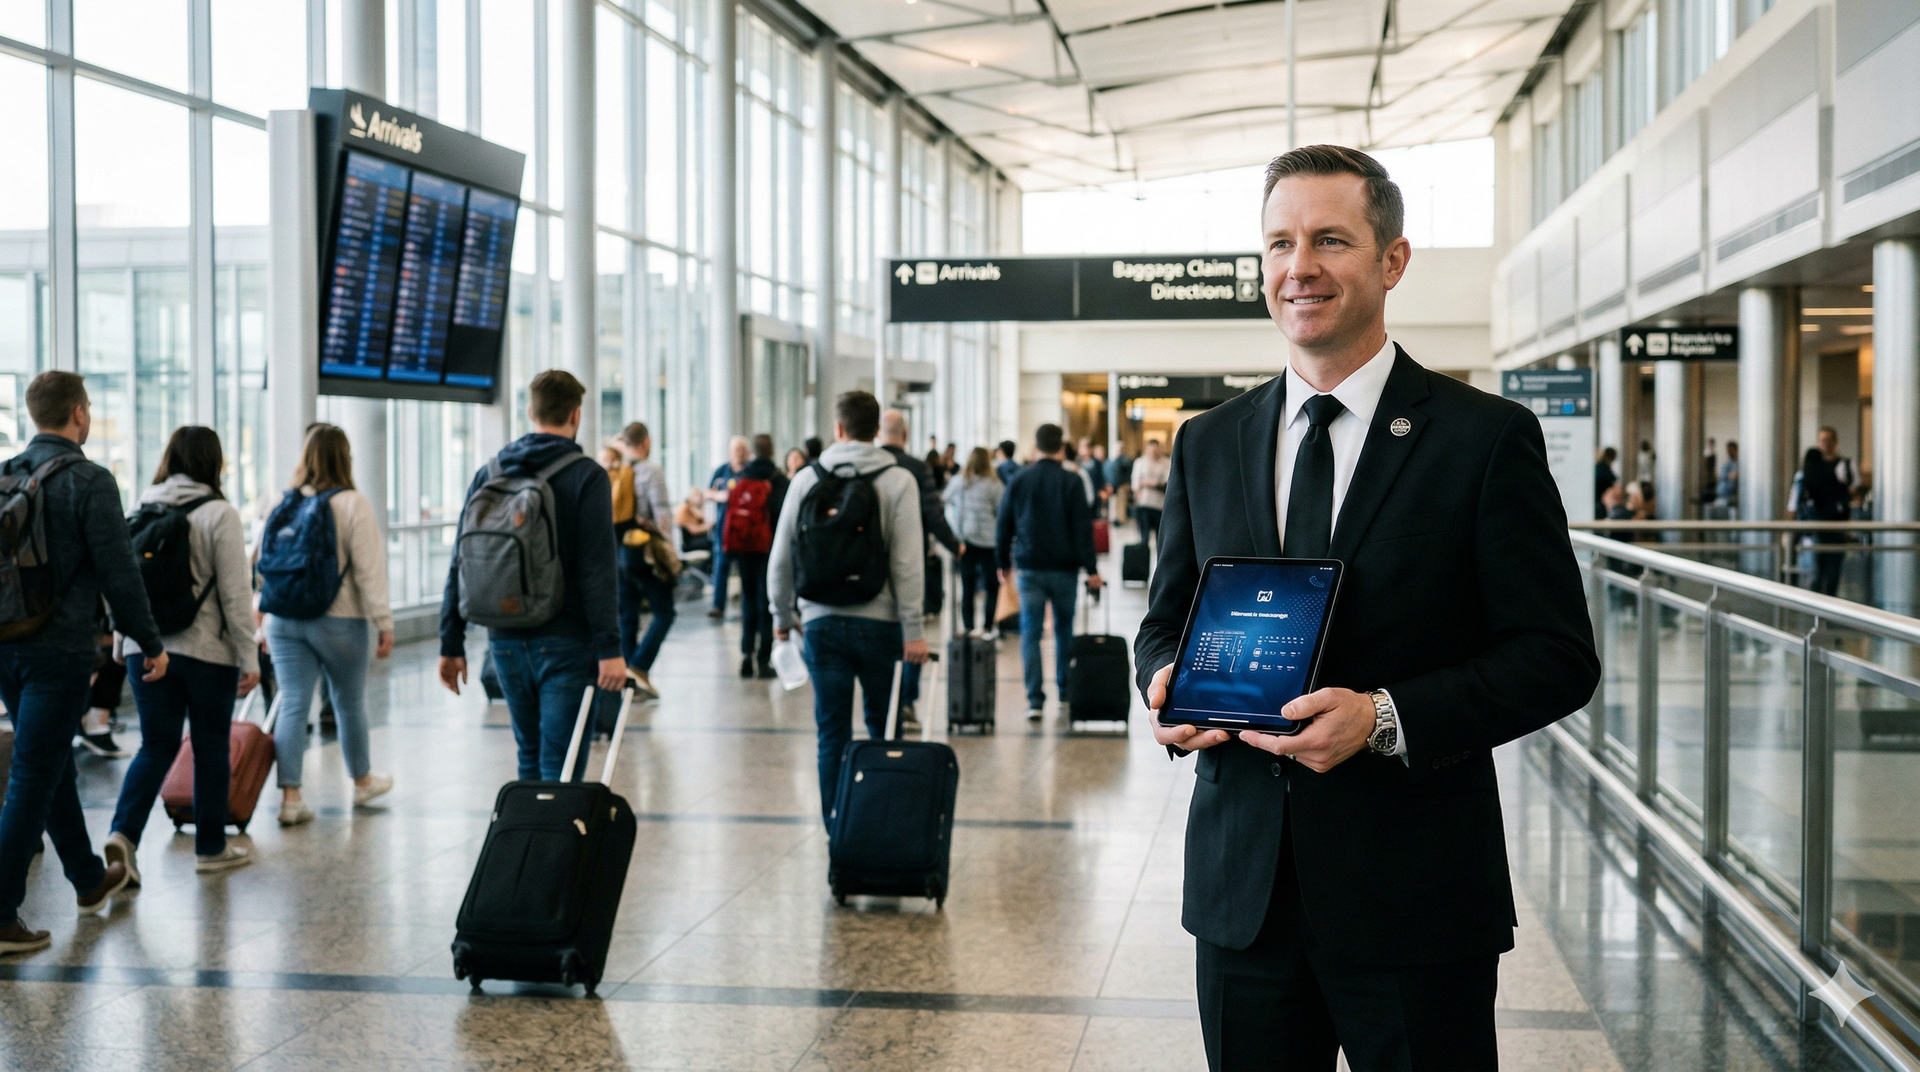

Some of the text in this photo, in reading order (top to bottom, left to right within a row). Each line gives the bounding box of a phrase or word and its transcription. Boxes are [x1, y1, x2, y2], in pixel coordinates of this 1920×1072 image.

[367, 111, 423, 154] Arrivals
[939, 262, 1001, 281] Arrivals
[1112, 258, 1234, 282] Baggage Claim
[1151, 281, 1235, 301] Directions
